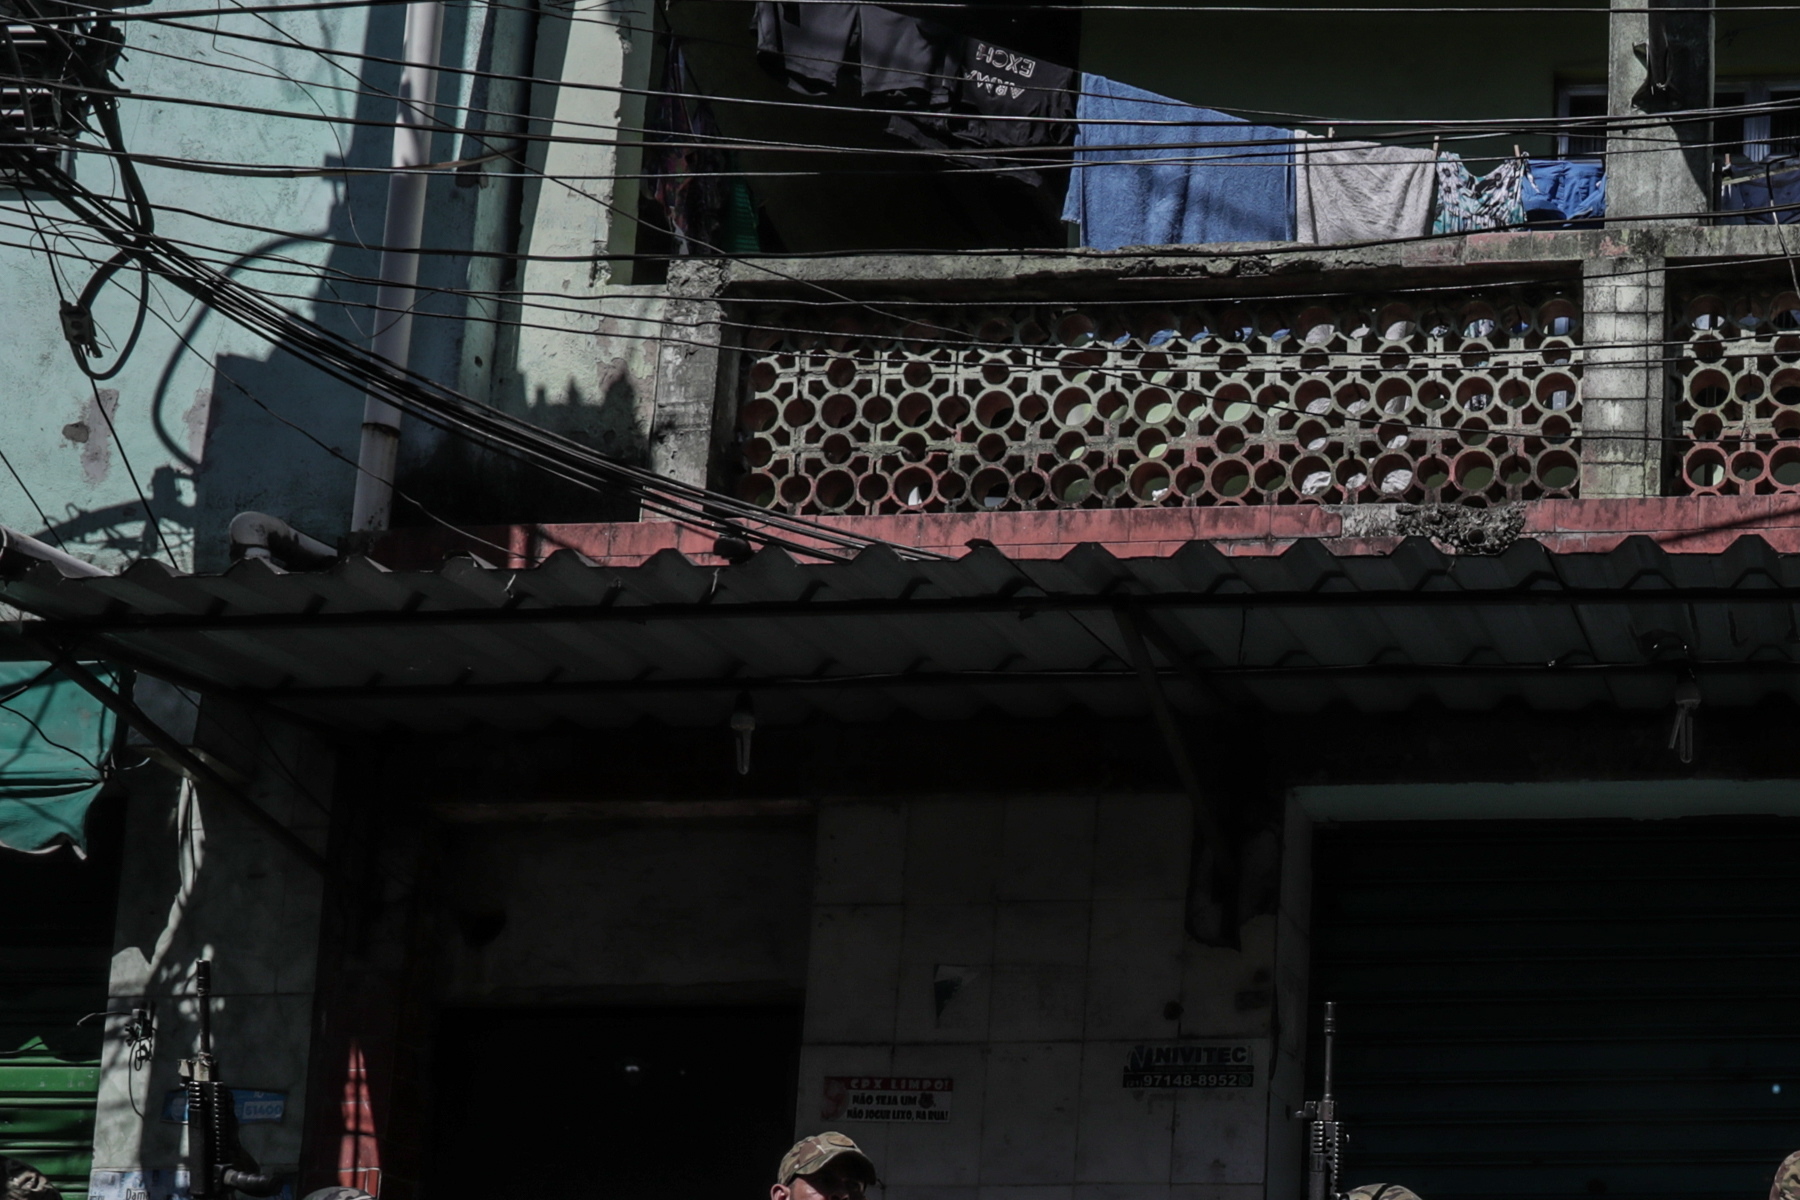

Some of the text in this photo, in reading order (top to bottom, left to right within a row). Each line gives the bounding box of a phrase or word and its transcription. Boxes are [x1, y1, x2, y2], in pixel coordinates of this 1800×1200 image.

[850, 1078, 949, 1090] CPX LIMPO!
[1143, 1074, 1238, 1087] 97148-8952
[852, 1092, 917, 1105] NÃO SEJA UM
[847, 1107, 864, 1119] NÃO
[865, 1109, 891, 1119] JOGUE
[915, 1110, 927, 1120] NA
[927, 1110, 949, 1120] RUA!
[125, 1188, 150, 1200] Dama
